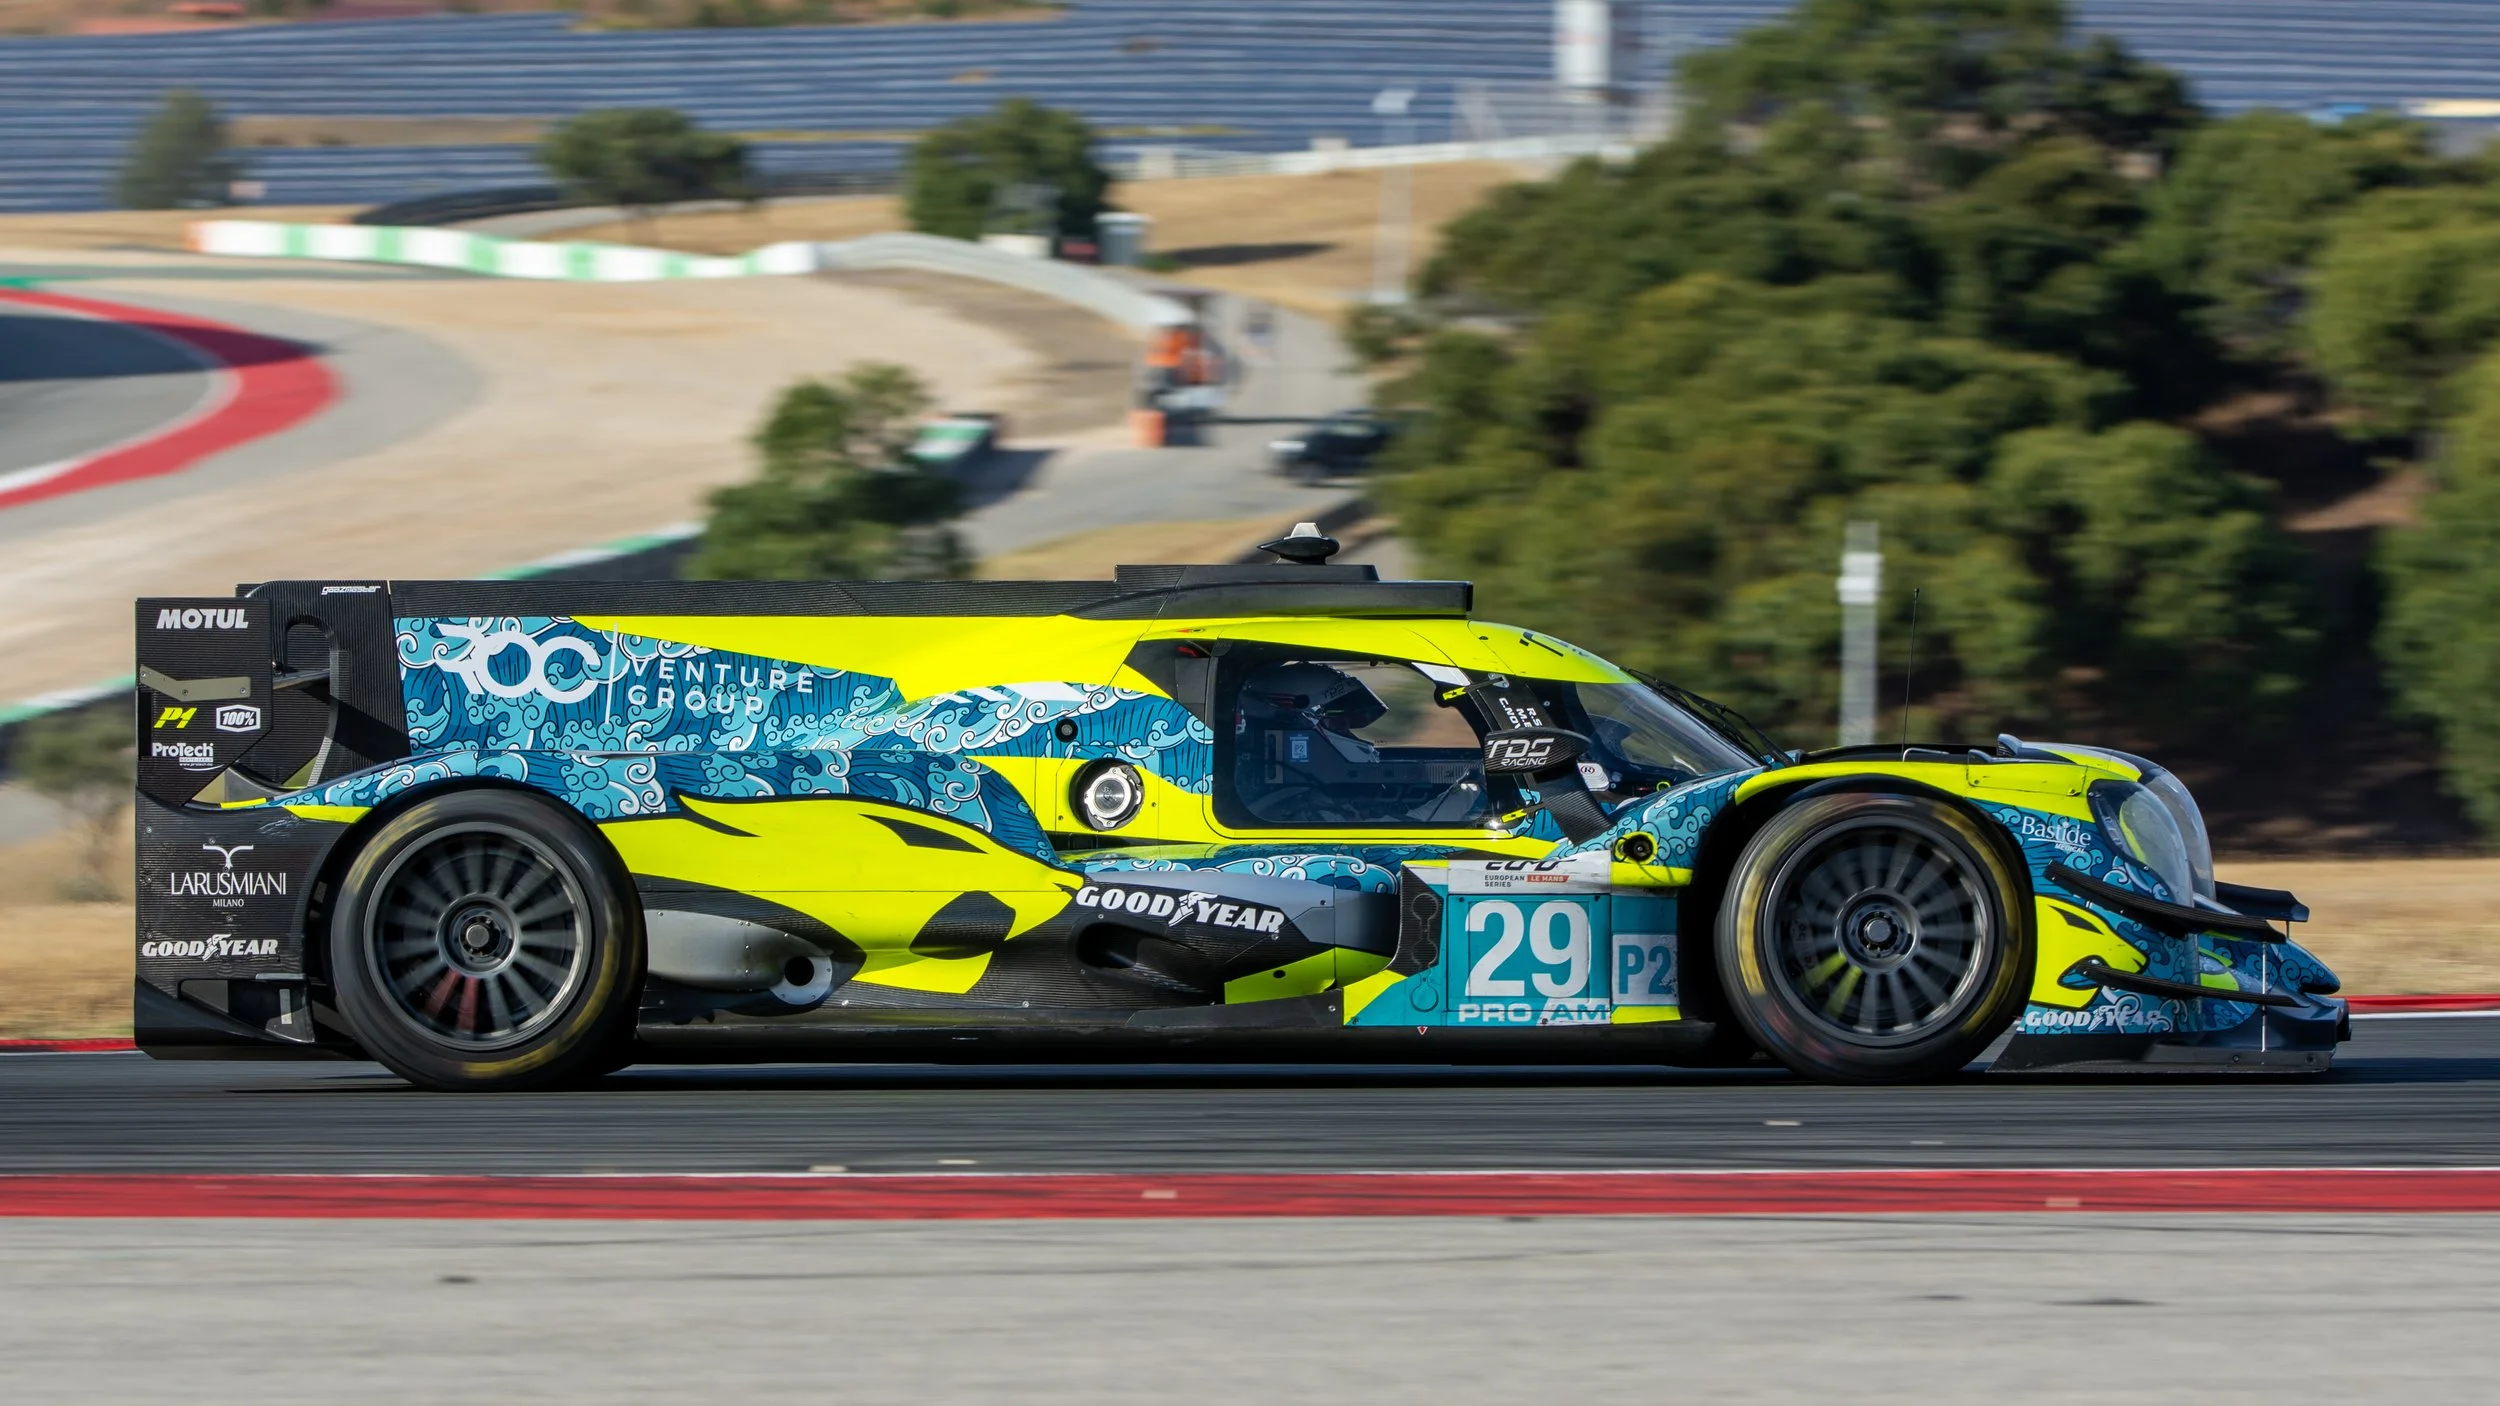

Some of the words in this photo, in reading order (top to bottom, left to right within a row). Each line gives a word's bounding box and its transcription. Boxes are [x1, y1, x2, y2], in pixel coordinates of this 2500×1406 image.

[156, 608, 249, 629] MOTUL
[631, 657, 815, 695] VENTURE
[627, 684, 765, 717] GROUP
[222, 711, 255, 726] 100%
[152, 742, 214, 757] ProTech
[1487, 737, 1555, 759] TDS
[1500, 757, 1548, 767] RACING
[2021, 816, 2092, 847] Bastide
[170, 871, 287, 896] LARUSMIANI
[212, 898, 245, 908] MILANO
[1464, 899, 1592, 999] 29
[1617, 944, 1672, 995] P2
[1458, 1003, 1532, 1022] PRO
[1550, 1003, 1607, 1021] AM
